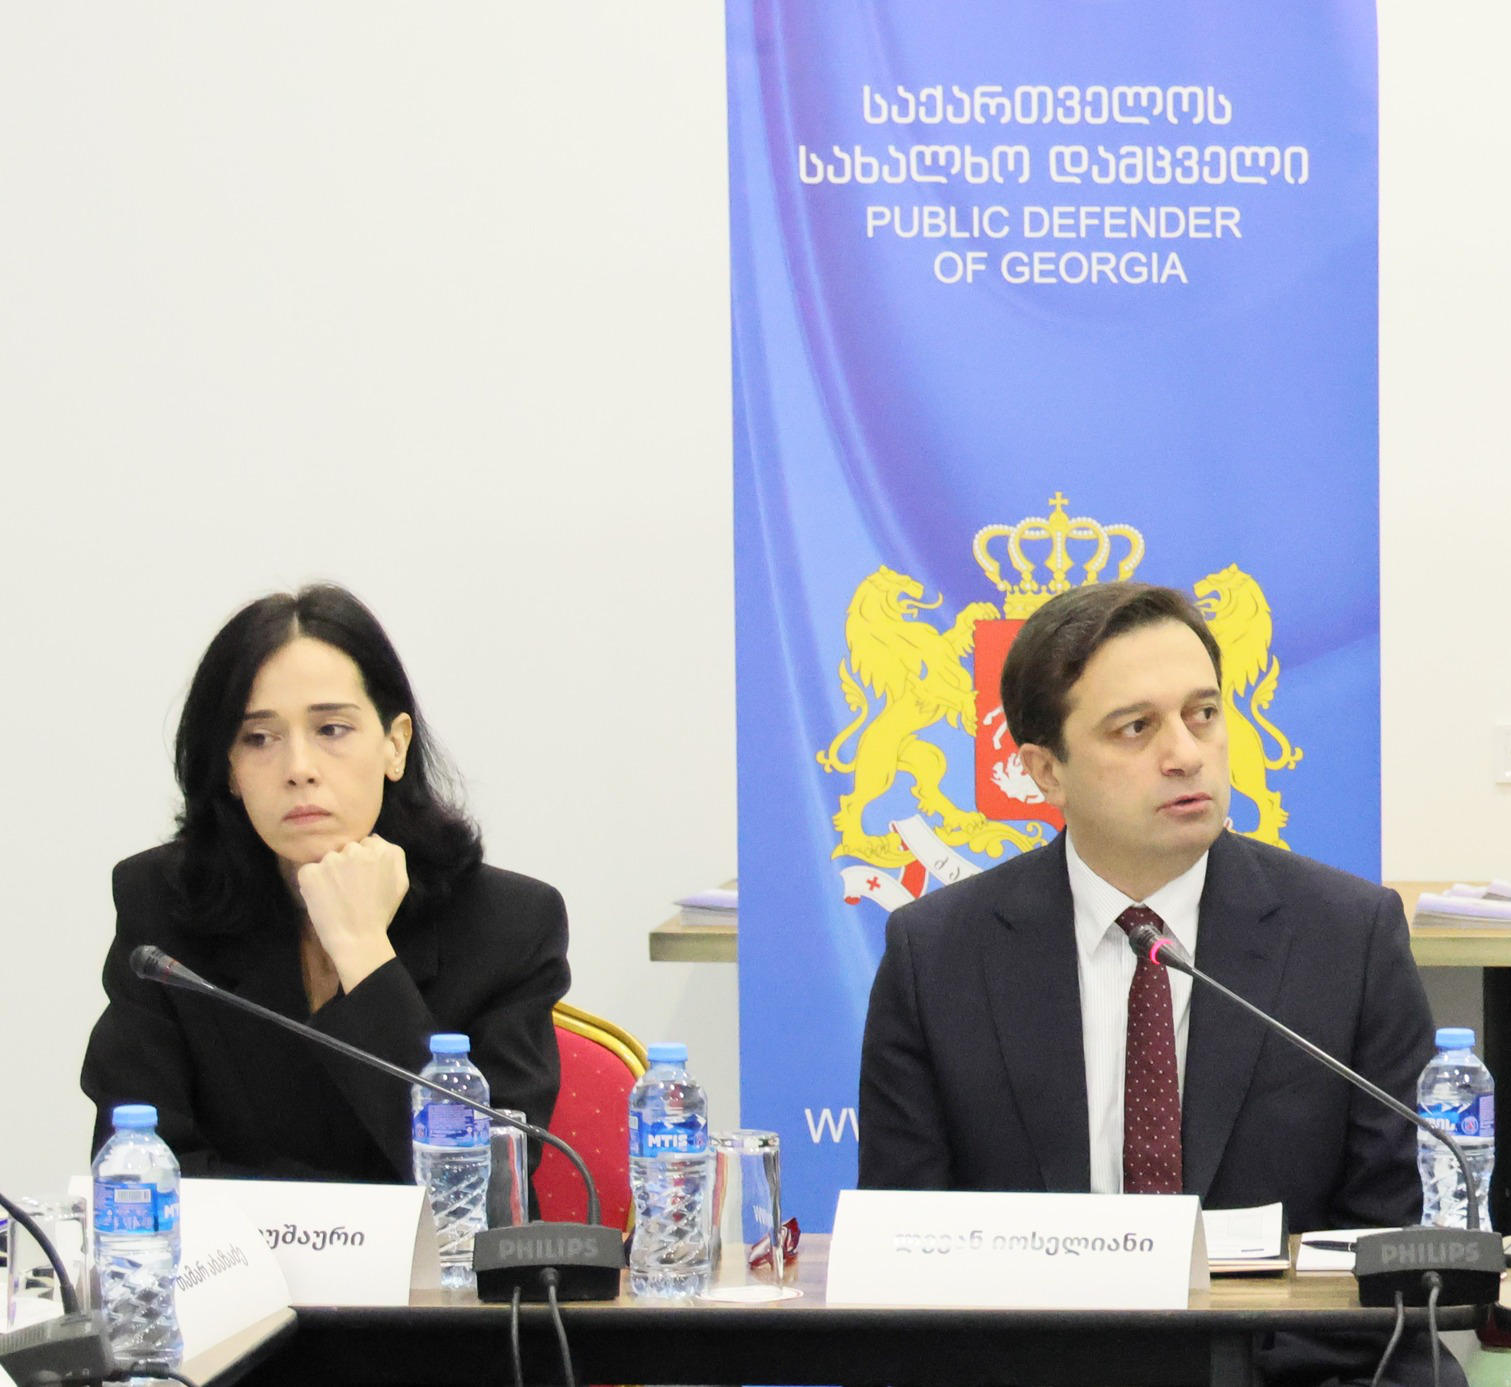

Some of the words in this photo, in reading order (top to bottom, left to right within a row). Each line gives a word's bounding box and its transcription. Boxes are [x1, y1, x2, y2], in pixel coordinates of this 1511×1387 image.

[862, 84, 1232, 125] საქართველოს
[798, 144, 1030, 184] სახალხო
[1048, 145, 1309, 185] დამცველი
[866, 205, 1010, 239] PUBLIC
[1023, 205, 1243, 239] DEFENDER
[933, 250, 988, 284] OF
[1000, 251, 1189, 284] GEORGIA
[648, 1134, 688, 1149] MTIS
[258, 1224, 365, 1251] უშაური
[500, 1239, 599, 1260] PHILIPS
[992, 1230, 1154, 1256] იოსელიანი
[1381, 1242, 1480, 1265] PHILIPS
